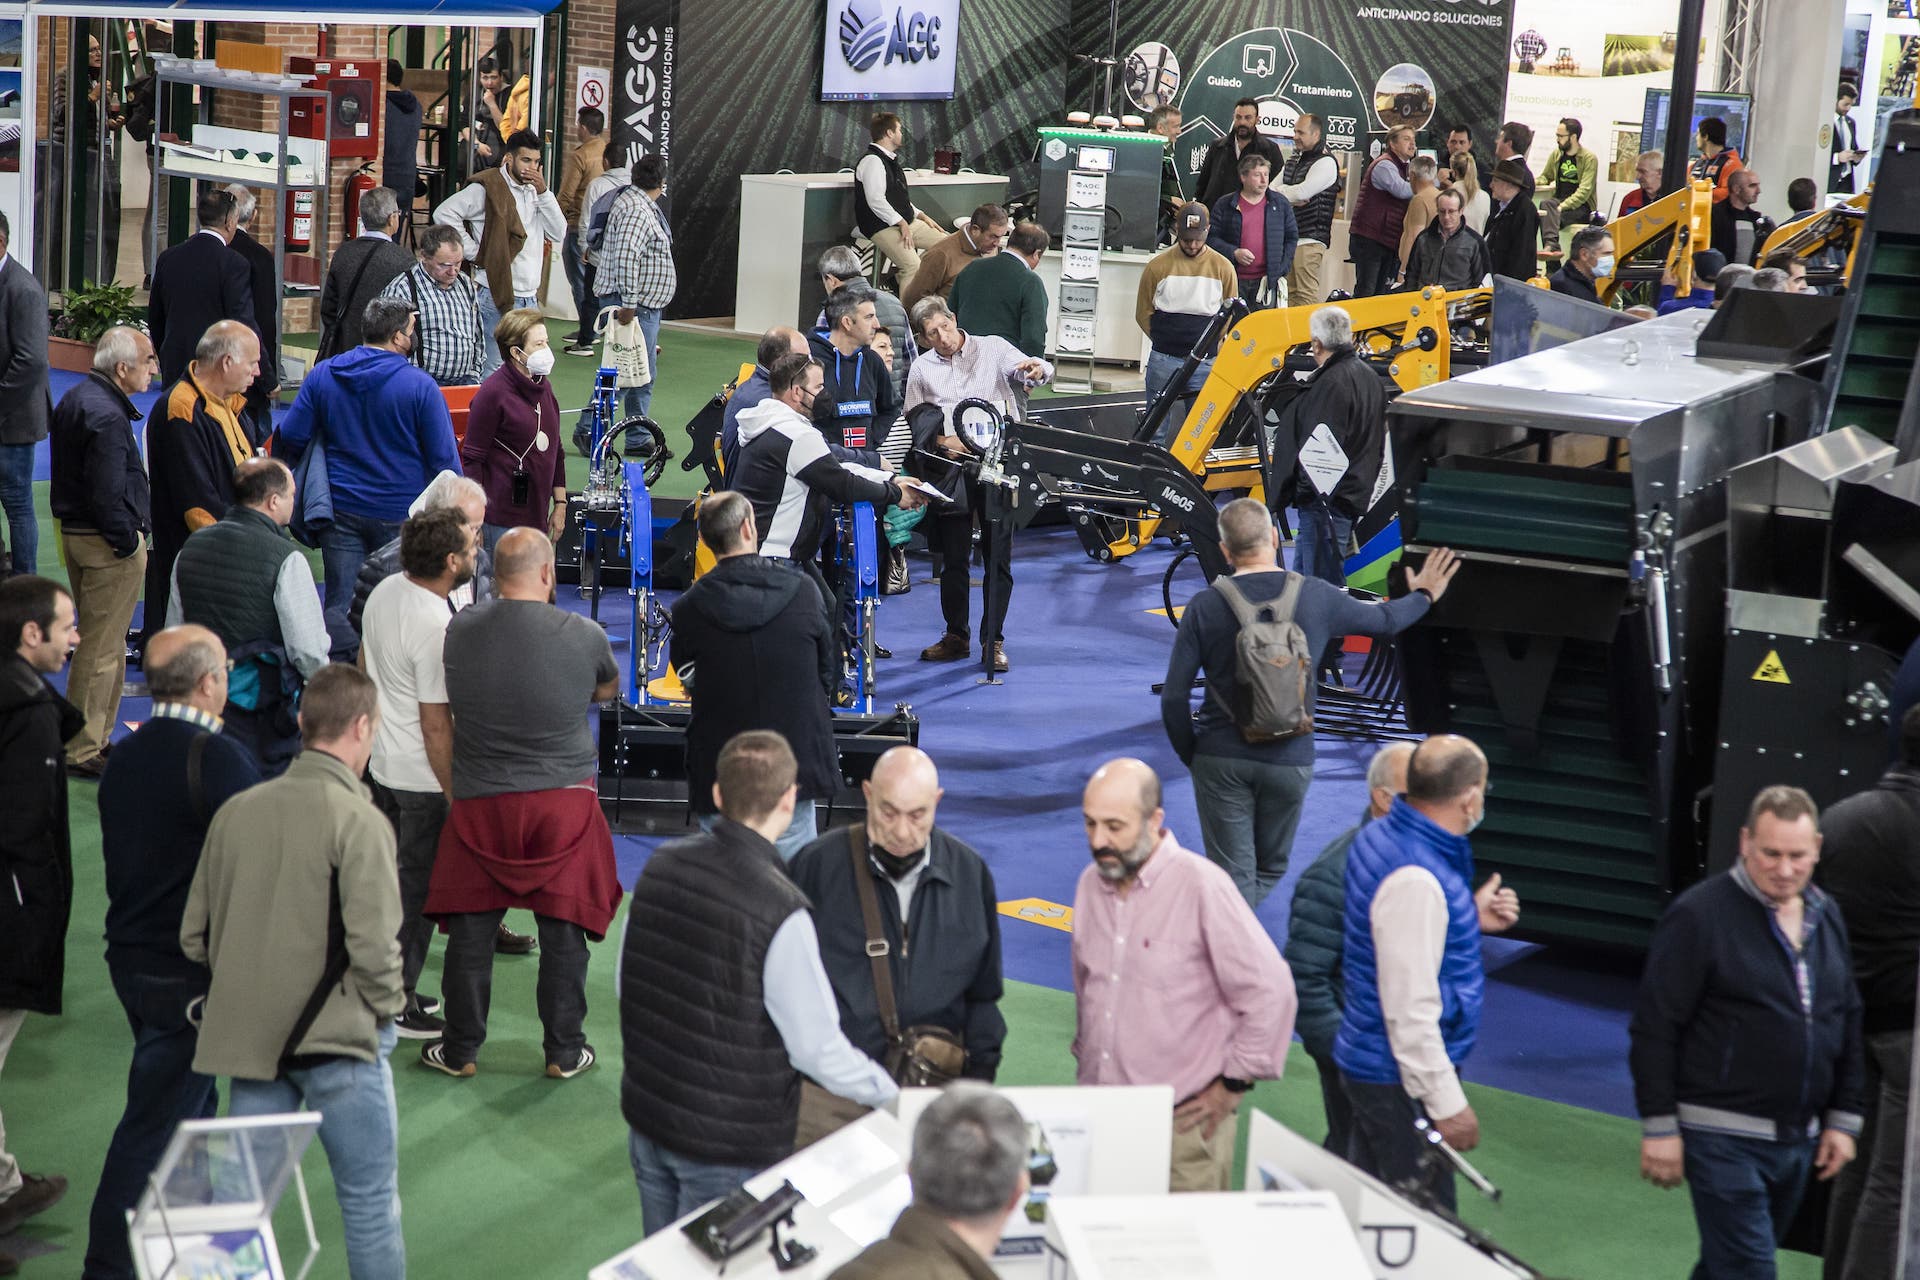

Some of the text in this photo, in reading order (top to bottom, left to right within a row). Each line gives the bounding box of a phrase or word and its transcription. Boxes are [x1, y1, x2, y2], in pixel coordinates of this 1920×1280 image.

[1357, 7, 1503, 27] ANTICIPANDO SOLUCIONES
[661, 26, 674, 108] SOLUCIONES
[624, 25, 658, 144] AGC
[1207, 75, 1243, 88] Guiado
[1292, 83, 1353, 98] Tratamiento
[1510, 93, 1593, 108] Trazabilidad GPS
